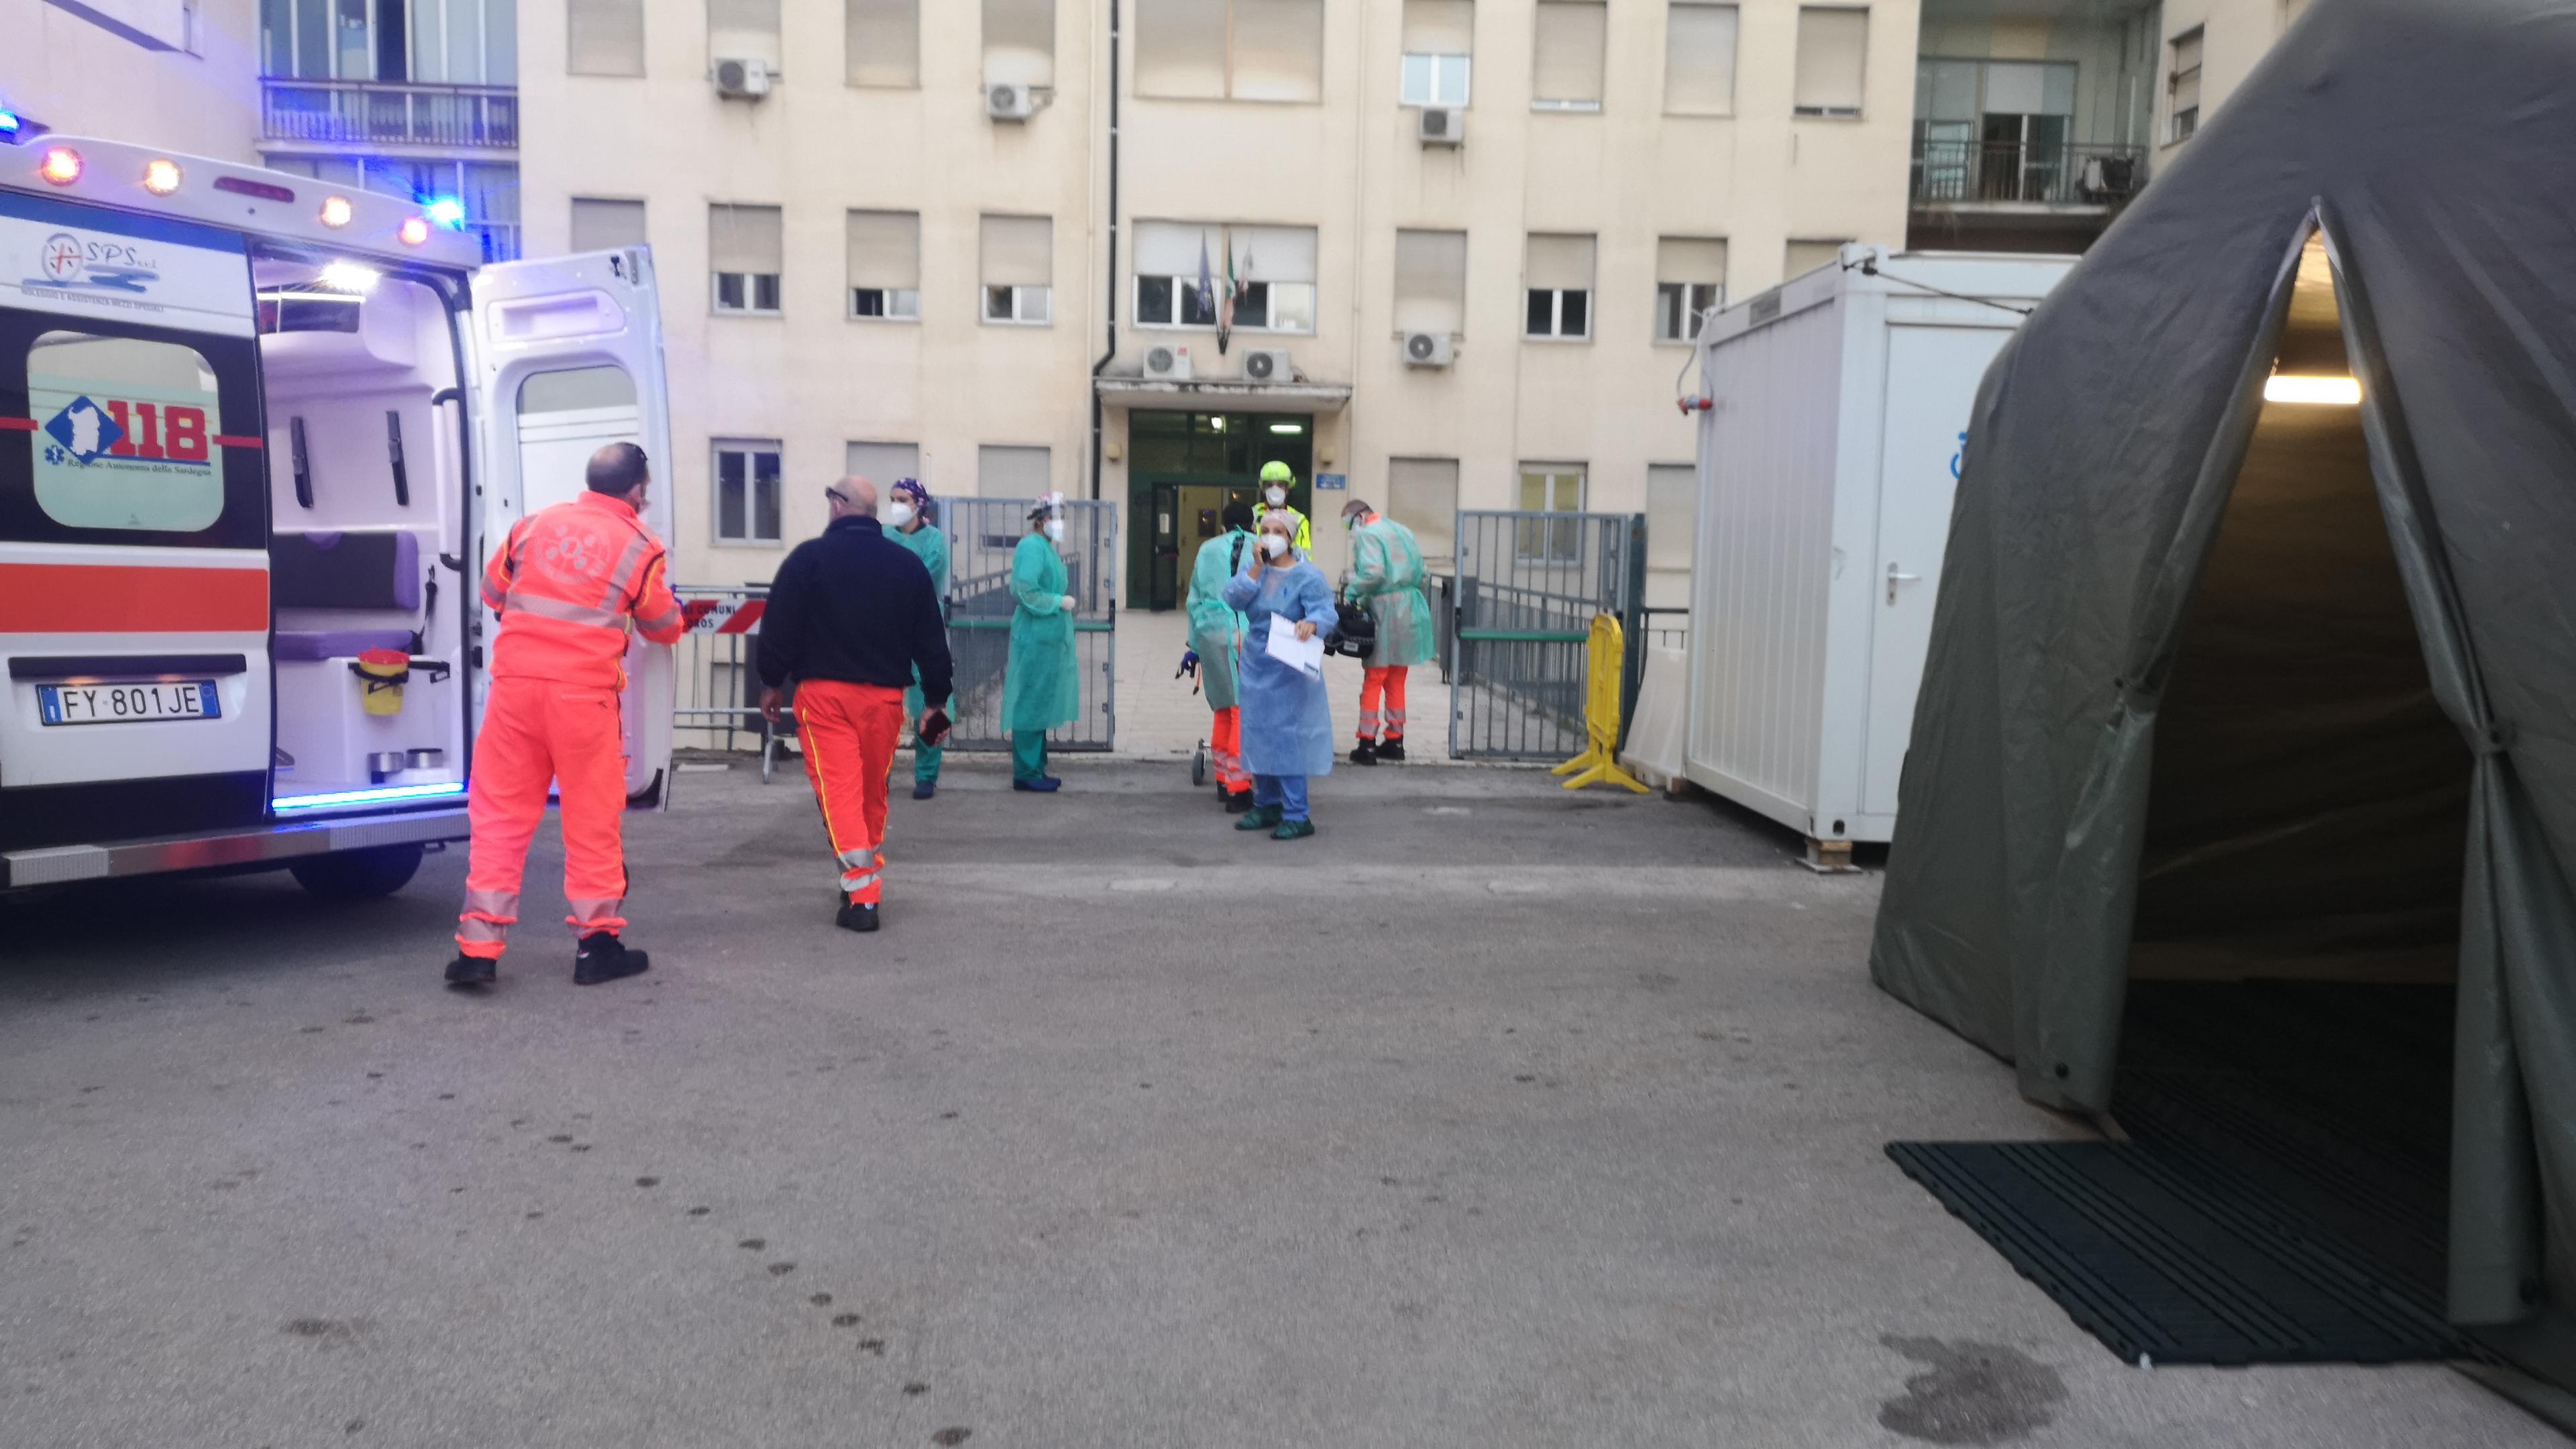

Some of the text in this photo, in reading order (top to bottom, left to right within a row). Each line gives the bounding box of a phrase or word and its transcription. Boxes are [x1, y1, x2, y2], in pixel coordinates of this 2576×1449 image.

[86, 242, 136, 266] SPS
[107, 400, 208, 461] 118
[107, 462, 150, 471] Autonoma
[152, 464, 172, 472] della
[174, 466, 211, 477] Sardegna
[64, 690, 96, 718] FY
